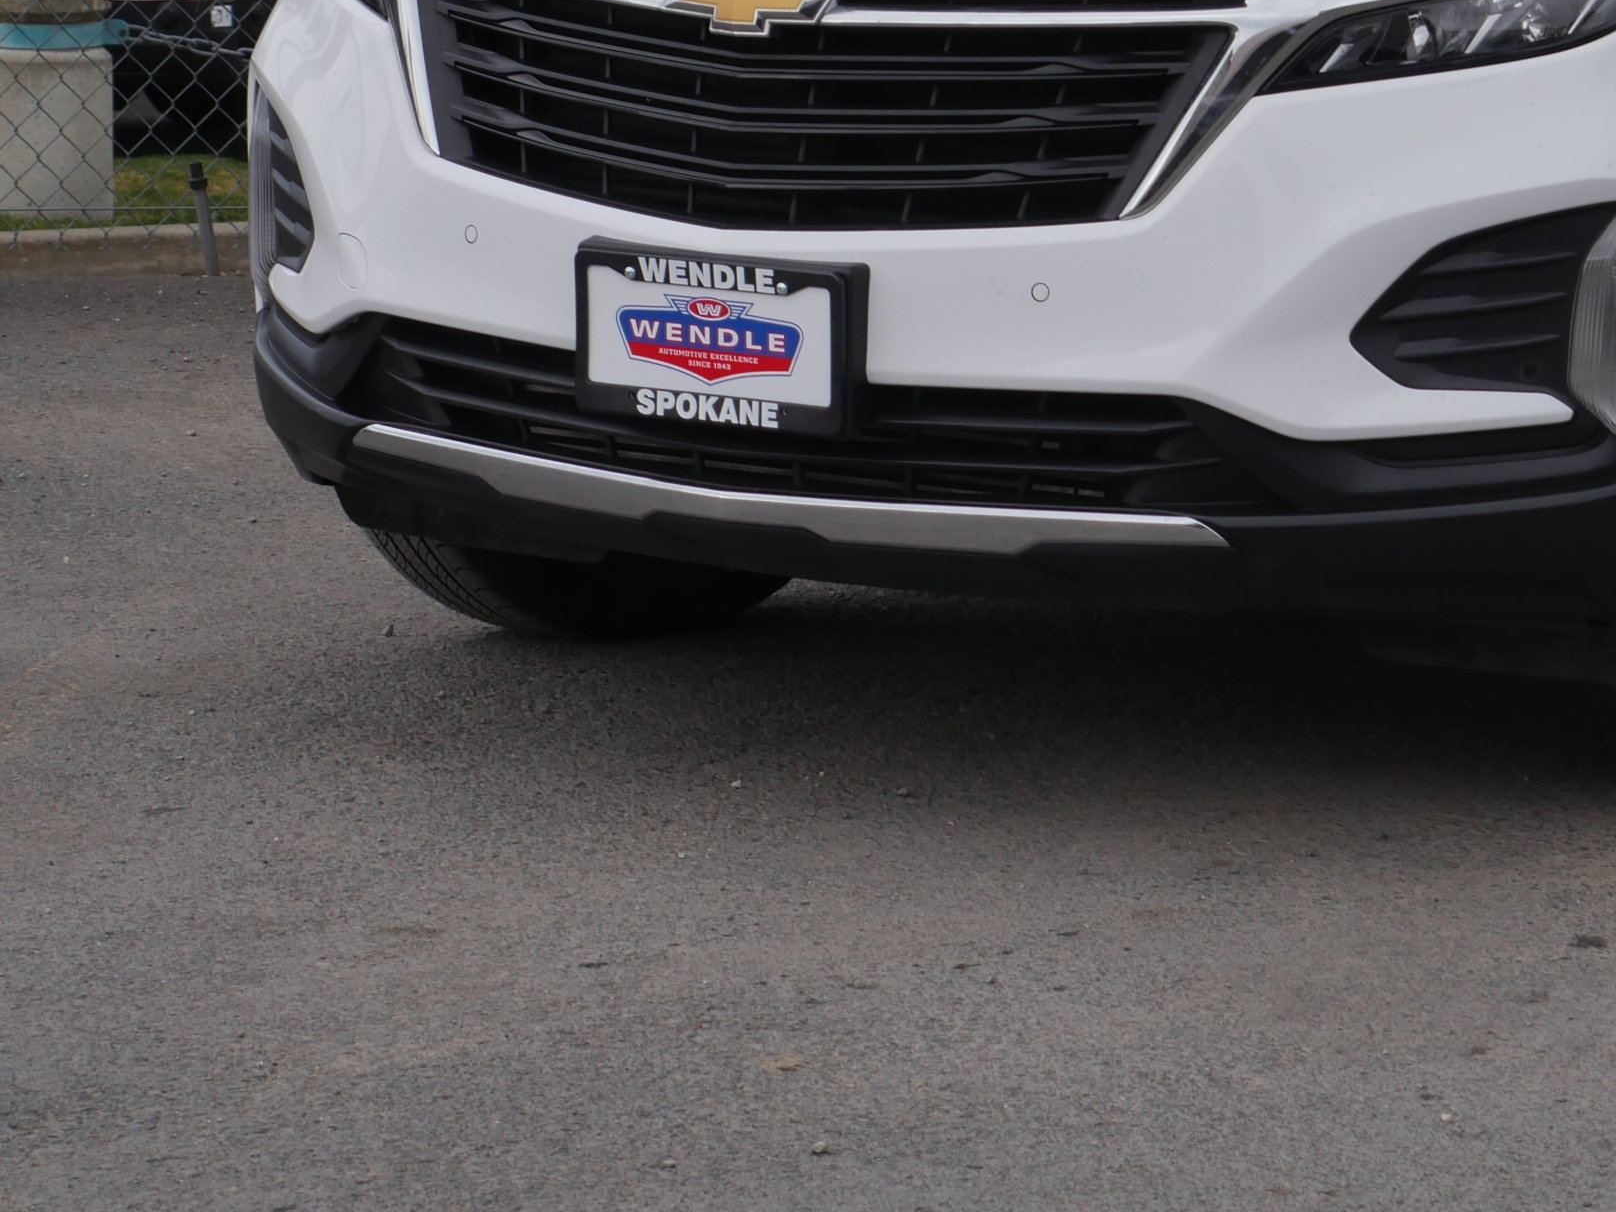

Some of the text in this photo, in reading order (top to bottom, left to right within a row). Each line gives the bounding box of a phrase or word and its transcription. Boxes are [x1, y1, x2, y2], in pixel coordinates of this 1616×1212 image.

[637, 256, 776, 295] WENDLE
[629, 318, 785, 353] WENDLE
[658, 347, 759, 365] AUTOMOTIVE EXCELLENCE
[687, 359, 731, 371] SINCE 1943
[636, 388, 779, 429] SPOKANE
